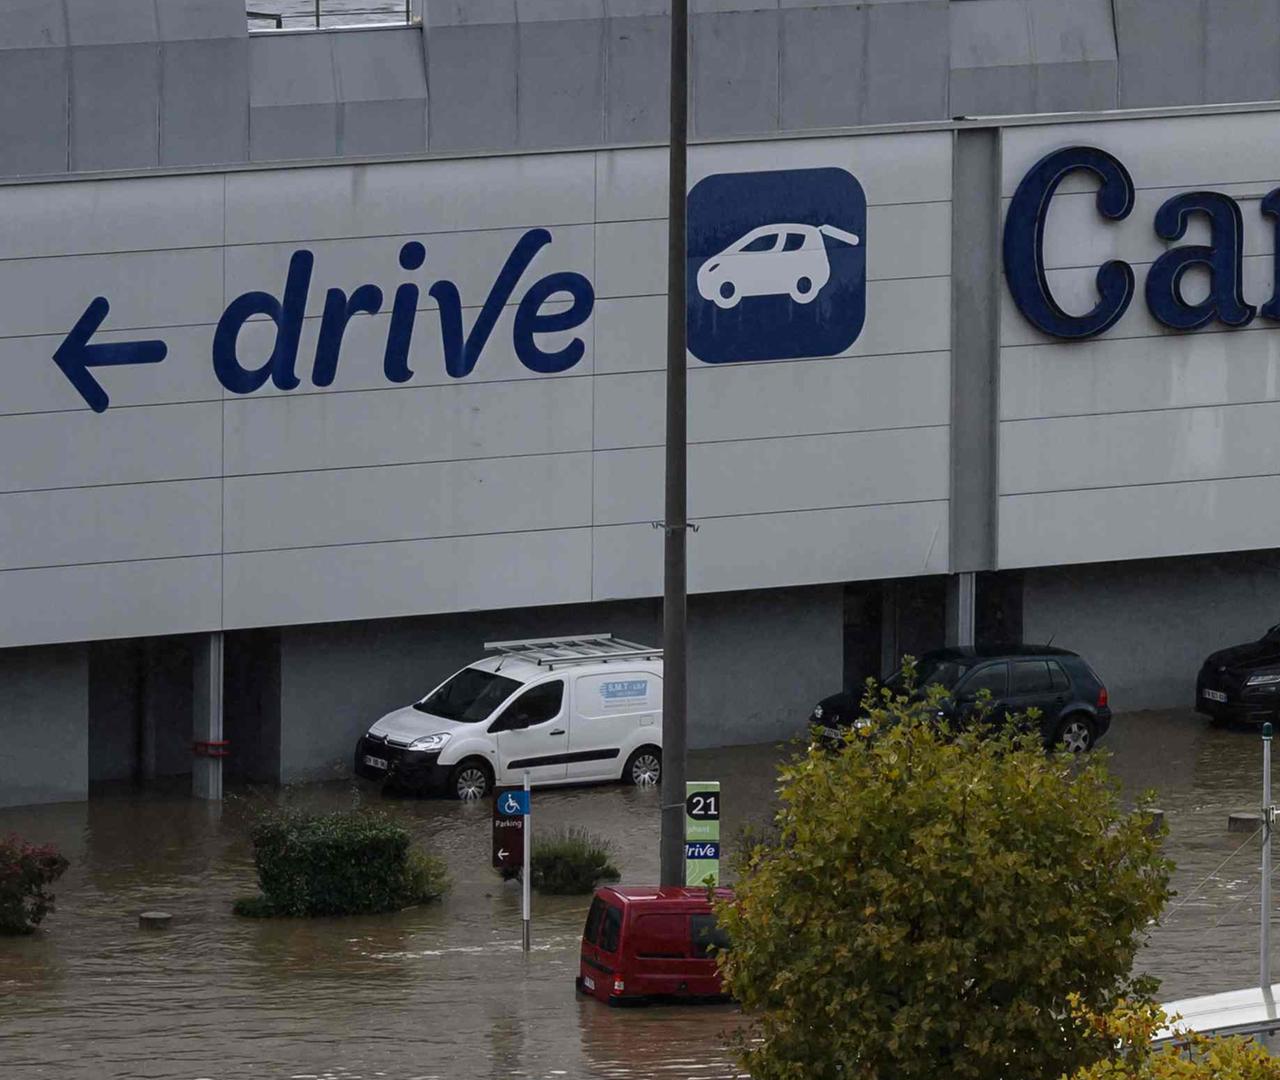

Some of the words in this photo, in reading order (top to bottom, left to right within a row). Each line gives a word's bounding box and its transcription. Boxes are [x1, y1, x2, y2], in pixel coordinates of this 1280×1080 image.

[214, 228, 592, 394] drive
[692, 797, 718, 814] 21
[495, 820, 522, 829] Parking
